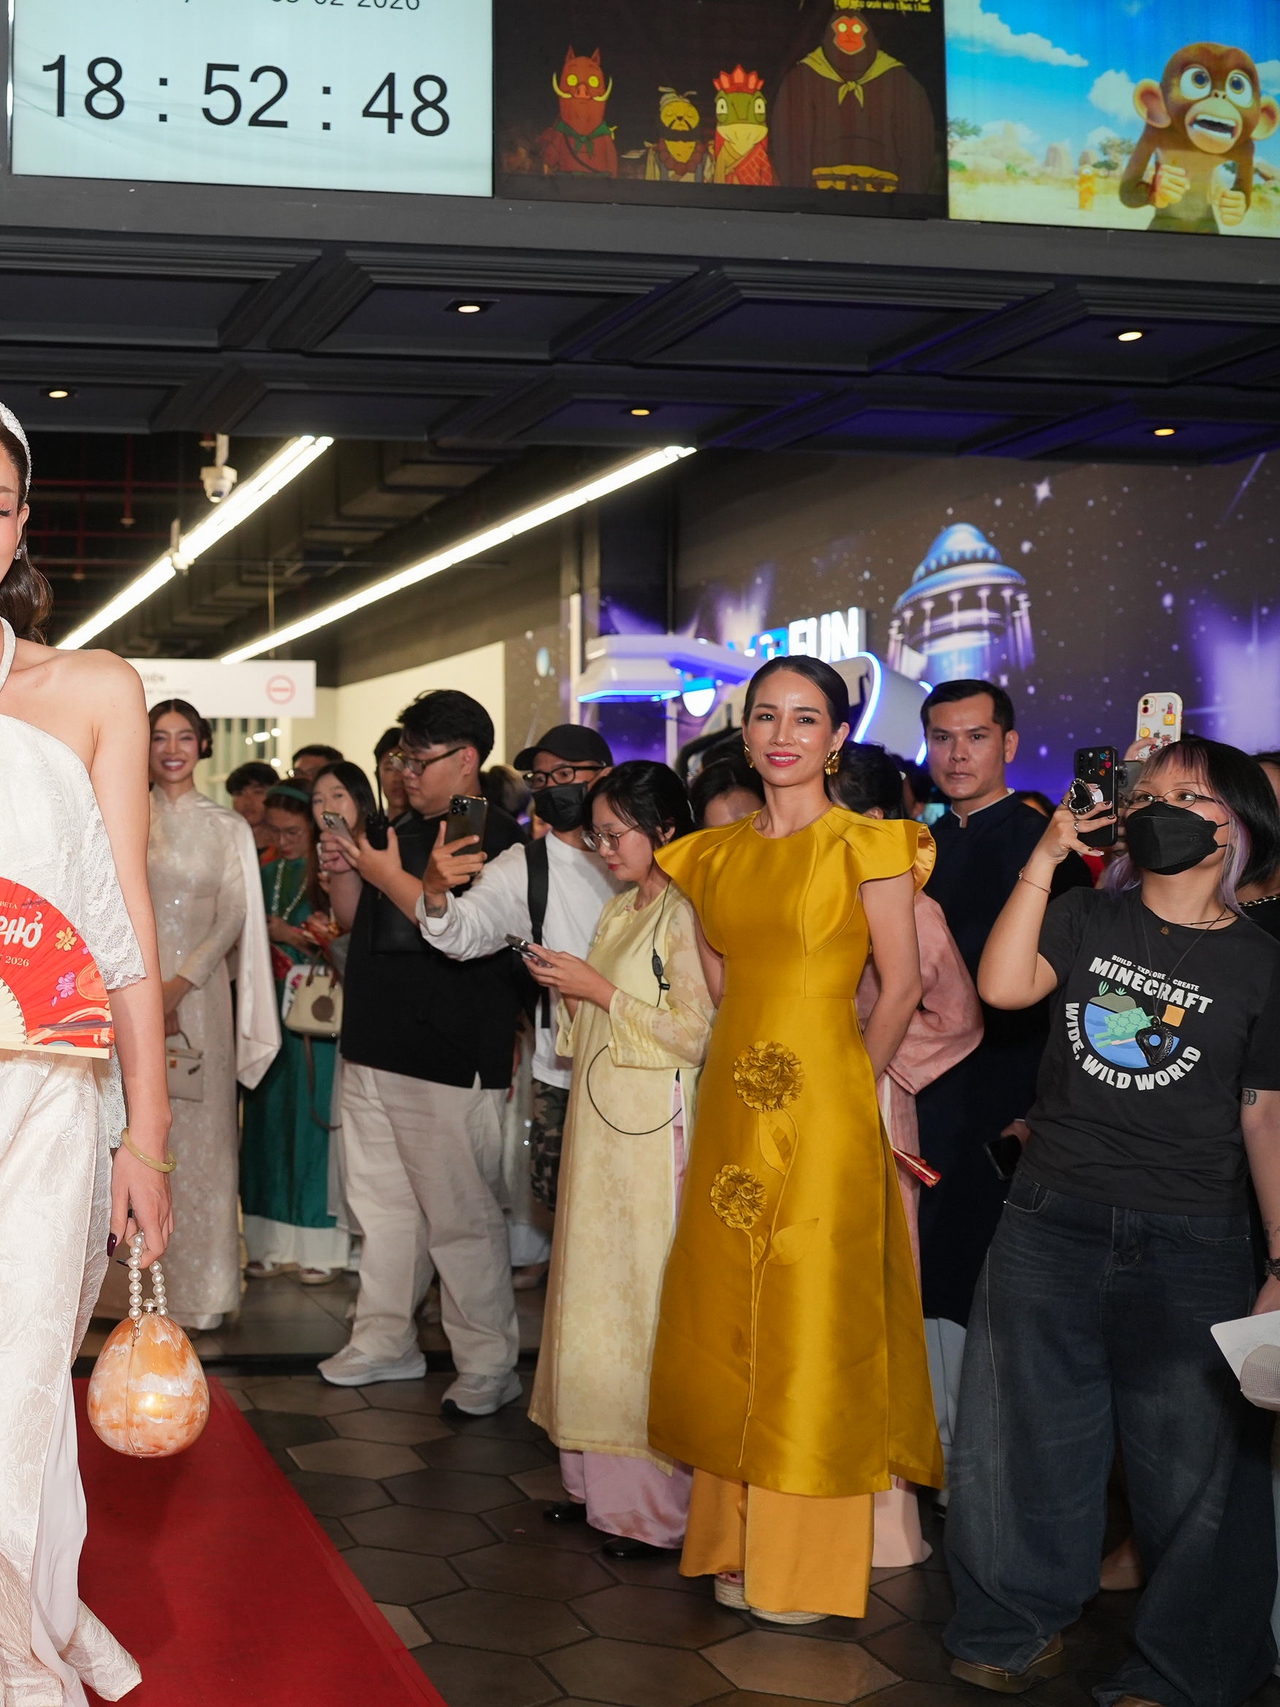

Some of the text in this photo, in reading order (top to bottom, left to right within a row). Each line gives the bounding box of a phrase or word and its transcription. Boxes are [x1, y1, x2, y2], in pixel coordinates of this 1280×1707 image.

[42, 54, 125, 120] 18
[201, 62, 289, 128] 52
[362, 71, 450, 137] 48
[5, 955, 30, 968] 2026
[1111, 954, 1133, 967] BUILD
[1172, 978, 1200, 992] CREATE
[1088, 956, 1214, 1015] MINECRAFT
[1081, 1053, 1132, 1090] WILD
[1134, 1045, 1202, 1091] WORLD
